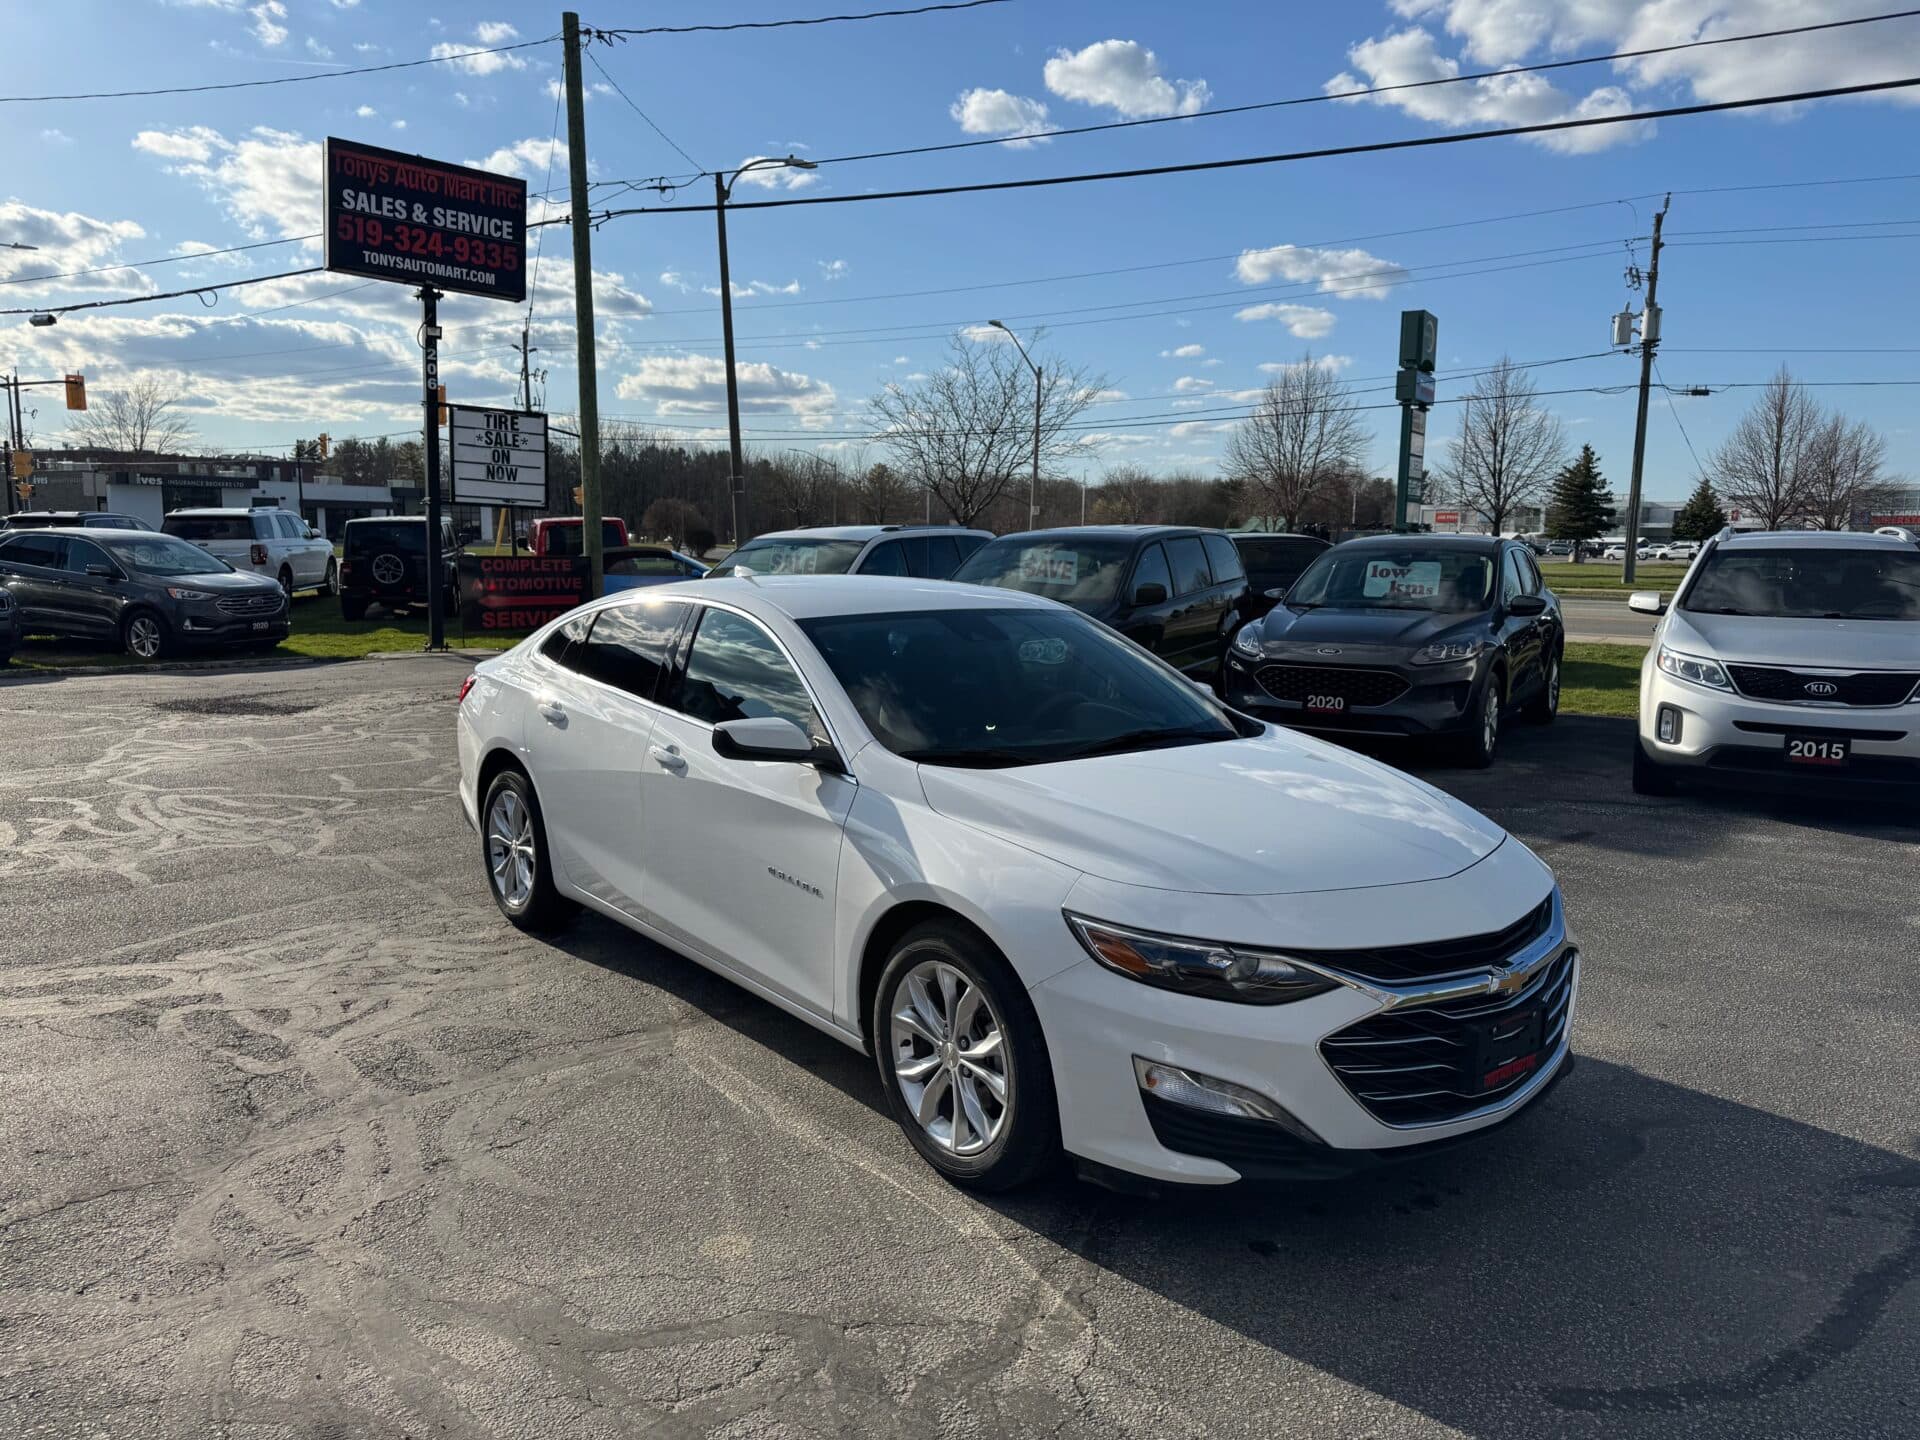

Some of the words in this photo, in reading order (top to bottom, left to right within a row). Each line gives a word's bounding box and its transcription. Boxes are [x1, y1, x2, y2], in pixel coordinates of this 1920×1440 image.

[335, 149, 389, 187] Tonys
[395, 163, 439, 193] Auto
[444, 174, 486, 203] Mart
[342, 188, 407, 220] SALES
[412, 203, 428, 224] &
[433, 206, 513, 240] SERVICE
[337, 214, 519, 272] 519-324-9335
[362, 250, 496, 286] TONYSAUTOMART.COM
[427, 348, 437, 390] 206
[484, 413, 520, 431] TIRE
[492, 449, 511, 465] ON
[136, 473, 163, 486] ives
[486, 464, 519, 482] NOW
[480, 559, 574, 572] COMPLETE
[770, 553, 816, 574] SALE
[1024, 558, 1074, 580] SAVE
[1371, 564, 1413, 578] low
[472, 577, 583, 592] AUTOMOTIVE
[1390, 580, 1434, 595] kms
[481, 609, 566, 629] SERVI
[1809, 682, 1833, 694] KIA
[1307, 694, 1345, 710] 2020
[1789, 739, 1845, 761] 2015
